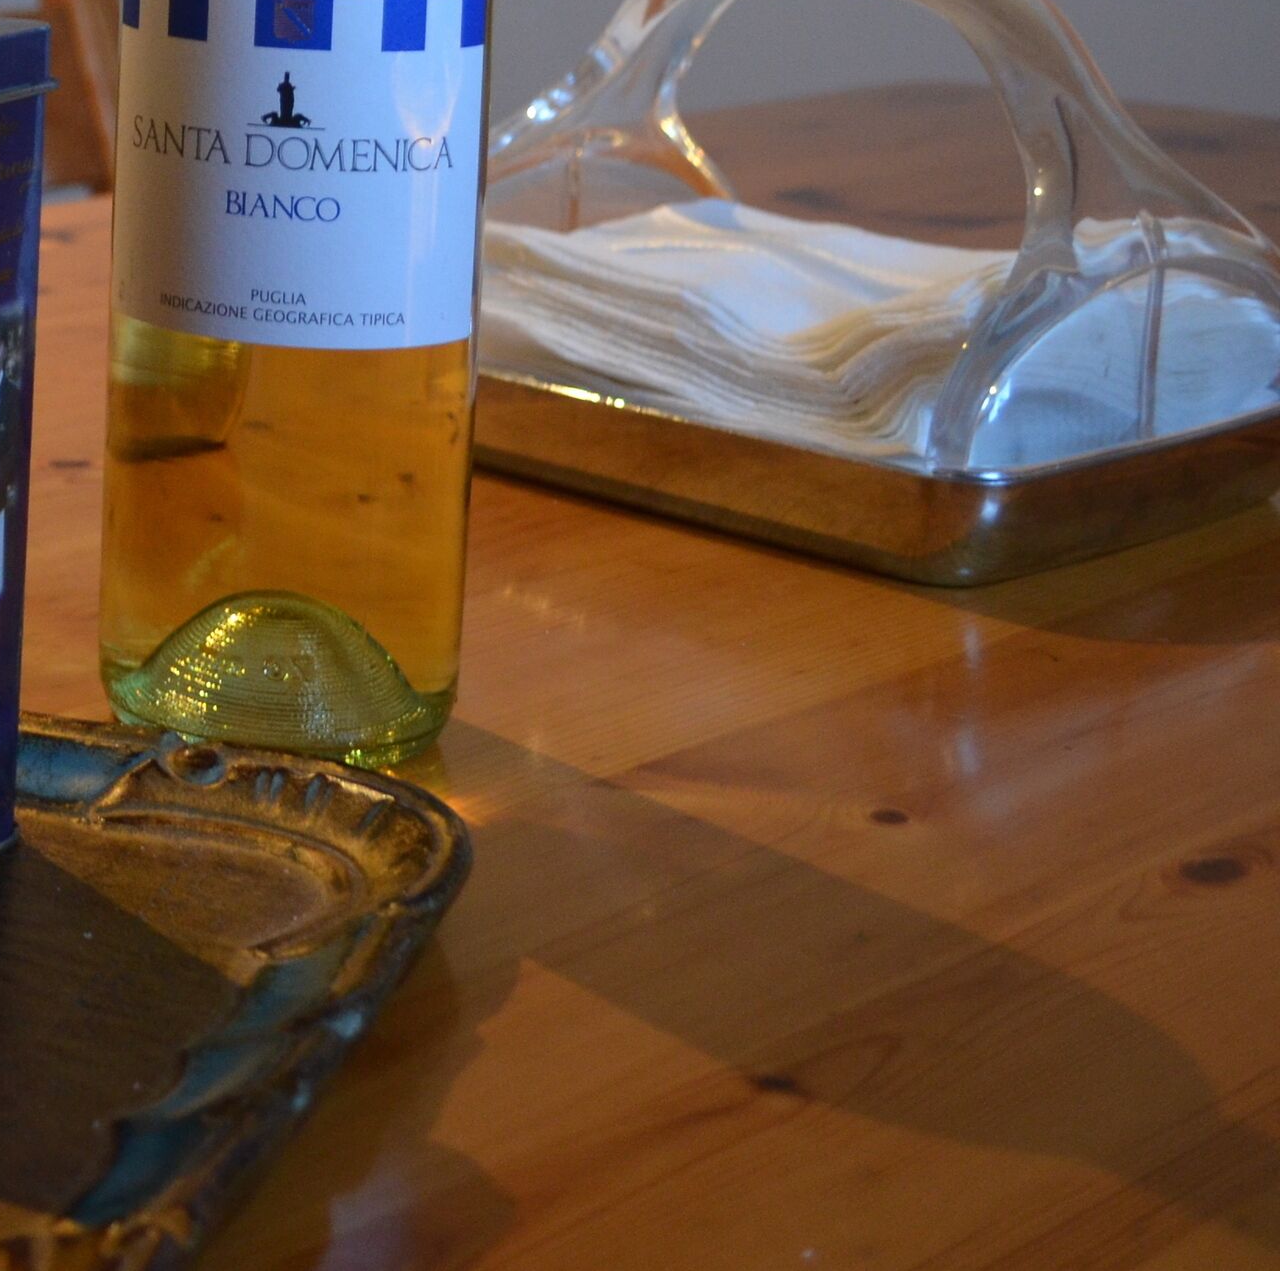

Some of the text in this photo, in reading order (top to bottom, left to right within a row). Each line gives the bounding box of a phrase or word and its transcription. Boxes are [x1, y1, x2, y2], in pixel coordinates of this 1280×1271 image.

[132, 115, 453, 172] SANTA DOMENICA
[225, 189, 340, 222] BIANCO
[160, 293, 405, 326] INDICAZIONE GEOGRAFICA TIPICA
[250, 288, 306, 305] PUGLIA
